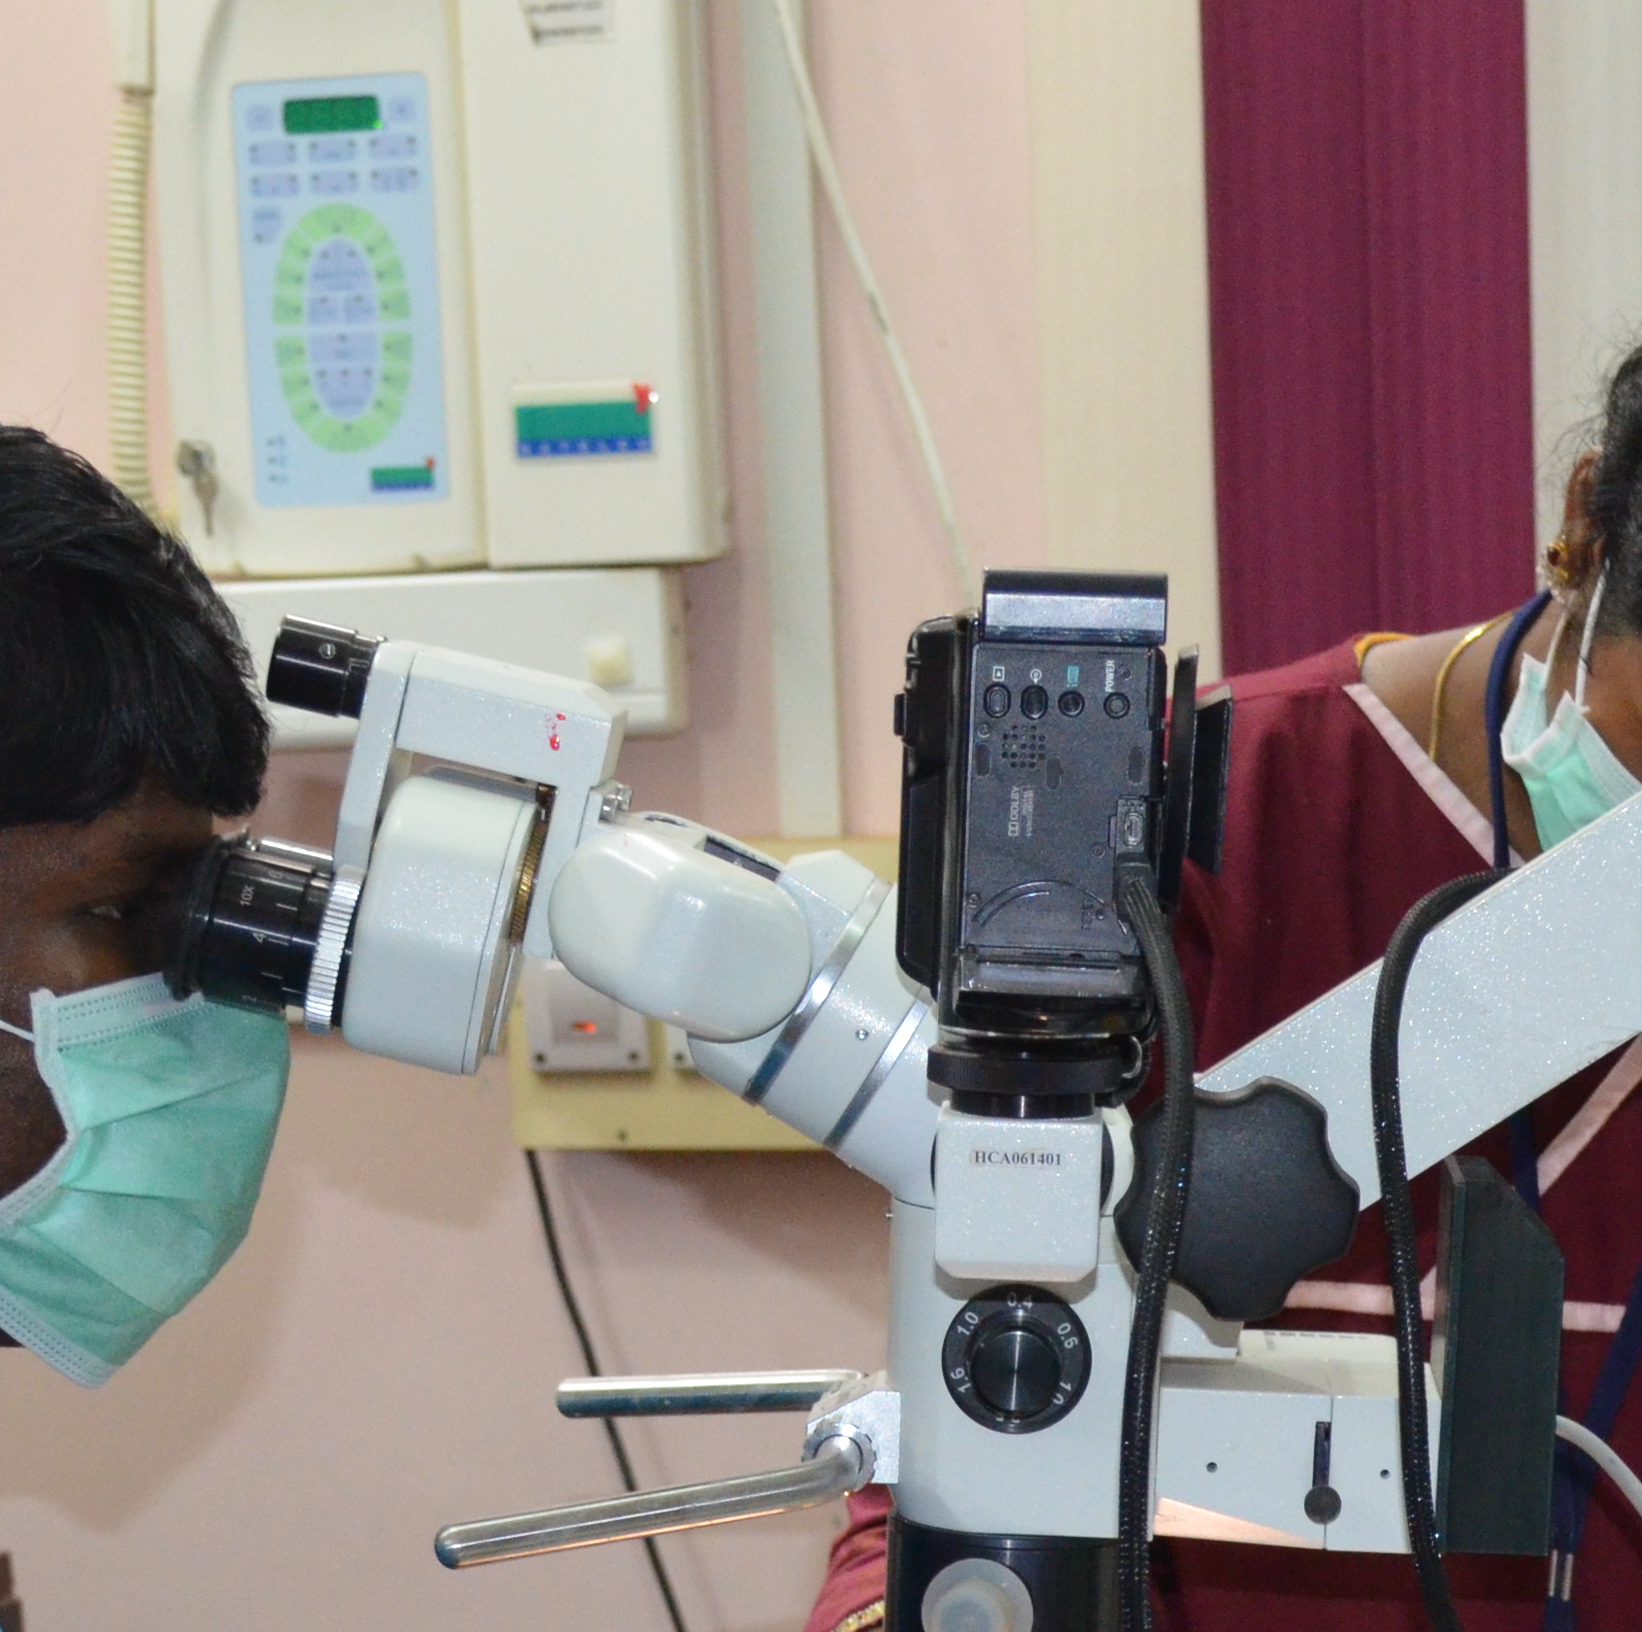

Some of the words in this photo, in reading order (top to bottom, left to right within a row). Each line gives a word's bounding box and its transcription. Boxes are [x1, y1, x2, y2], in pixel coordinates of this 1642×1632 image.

[1104, 660, 1115, 692] POWER
[1010, 786, 1019, 820] DOLBY
[240, 885, 255, 906] 10X
[253, 931, 268, 944] 4
[974, 1151, 1061, 1166] HCA061401
[957, 1311, 979, 1337] 1.0
[1057, 1323, 1079, 1349] 0.6
[950, 1367, 972, 1394] 1.6
